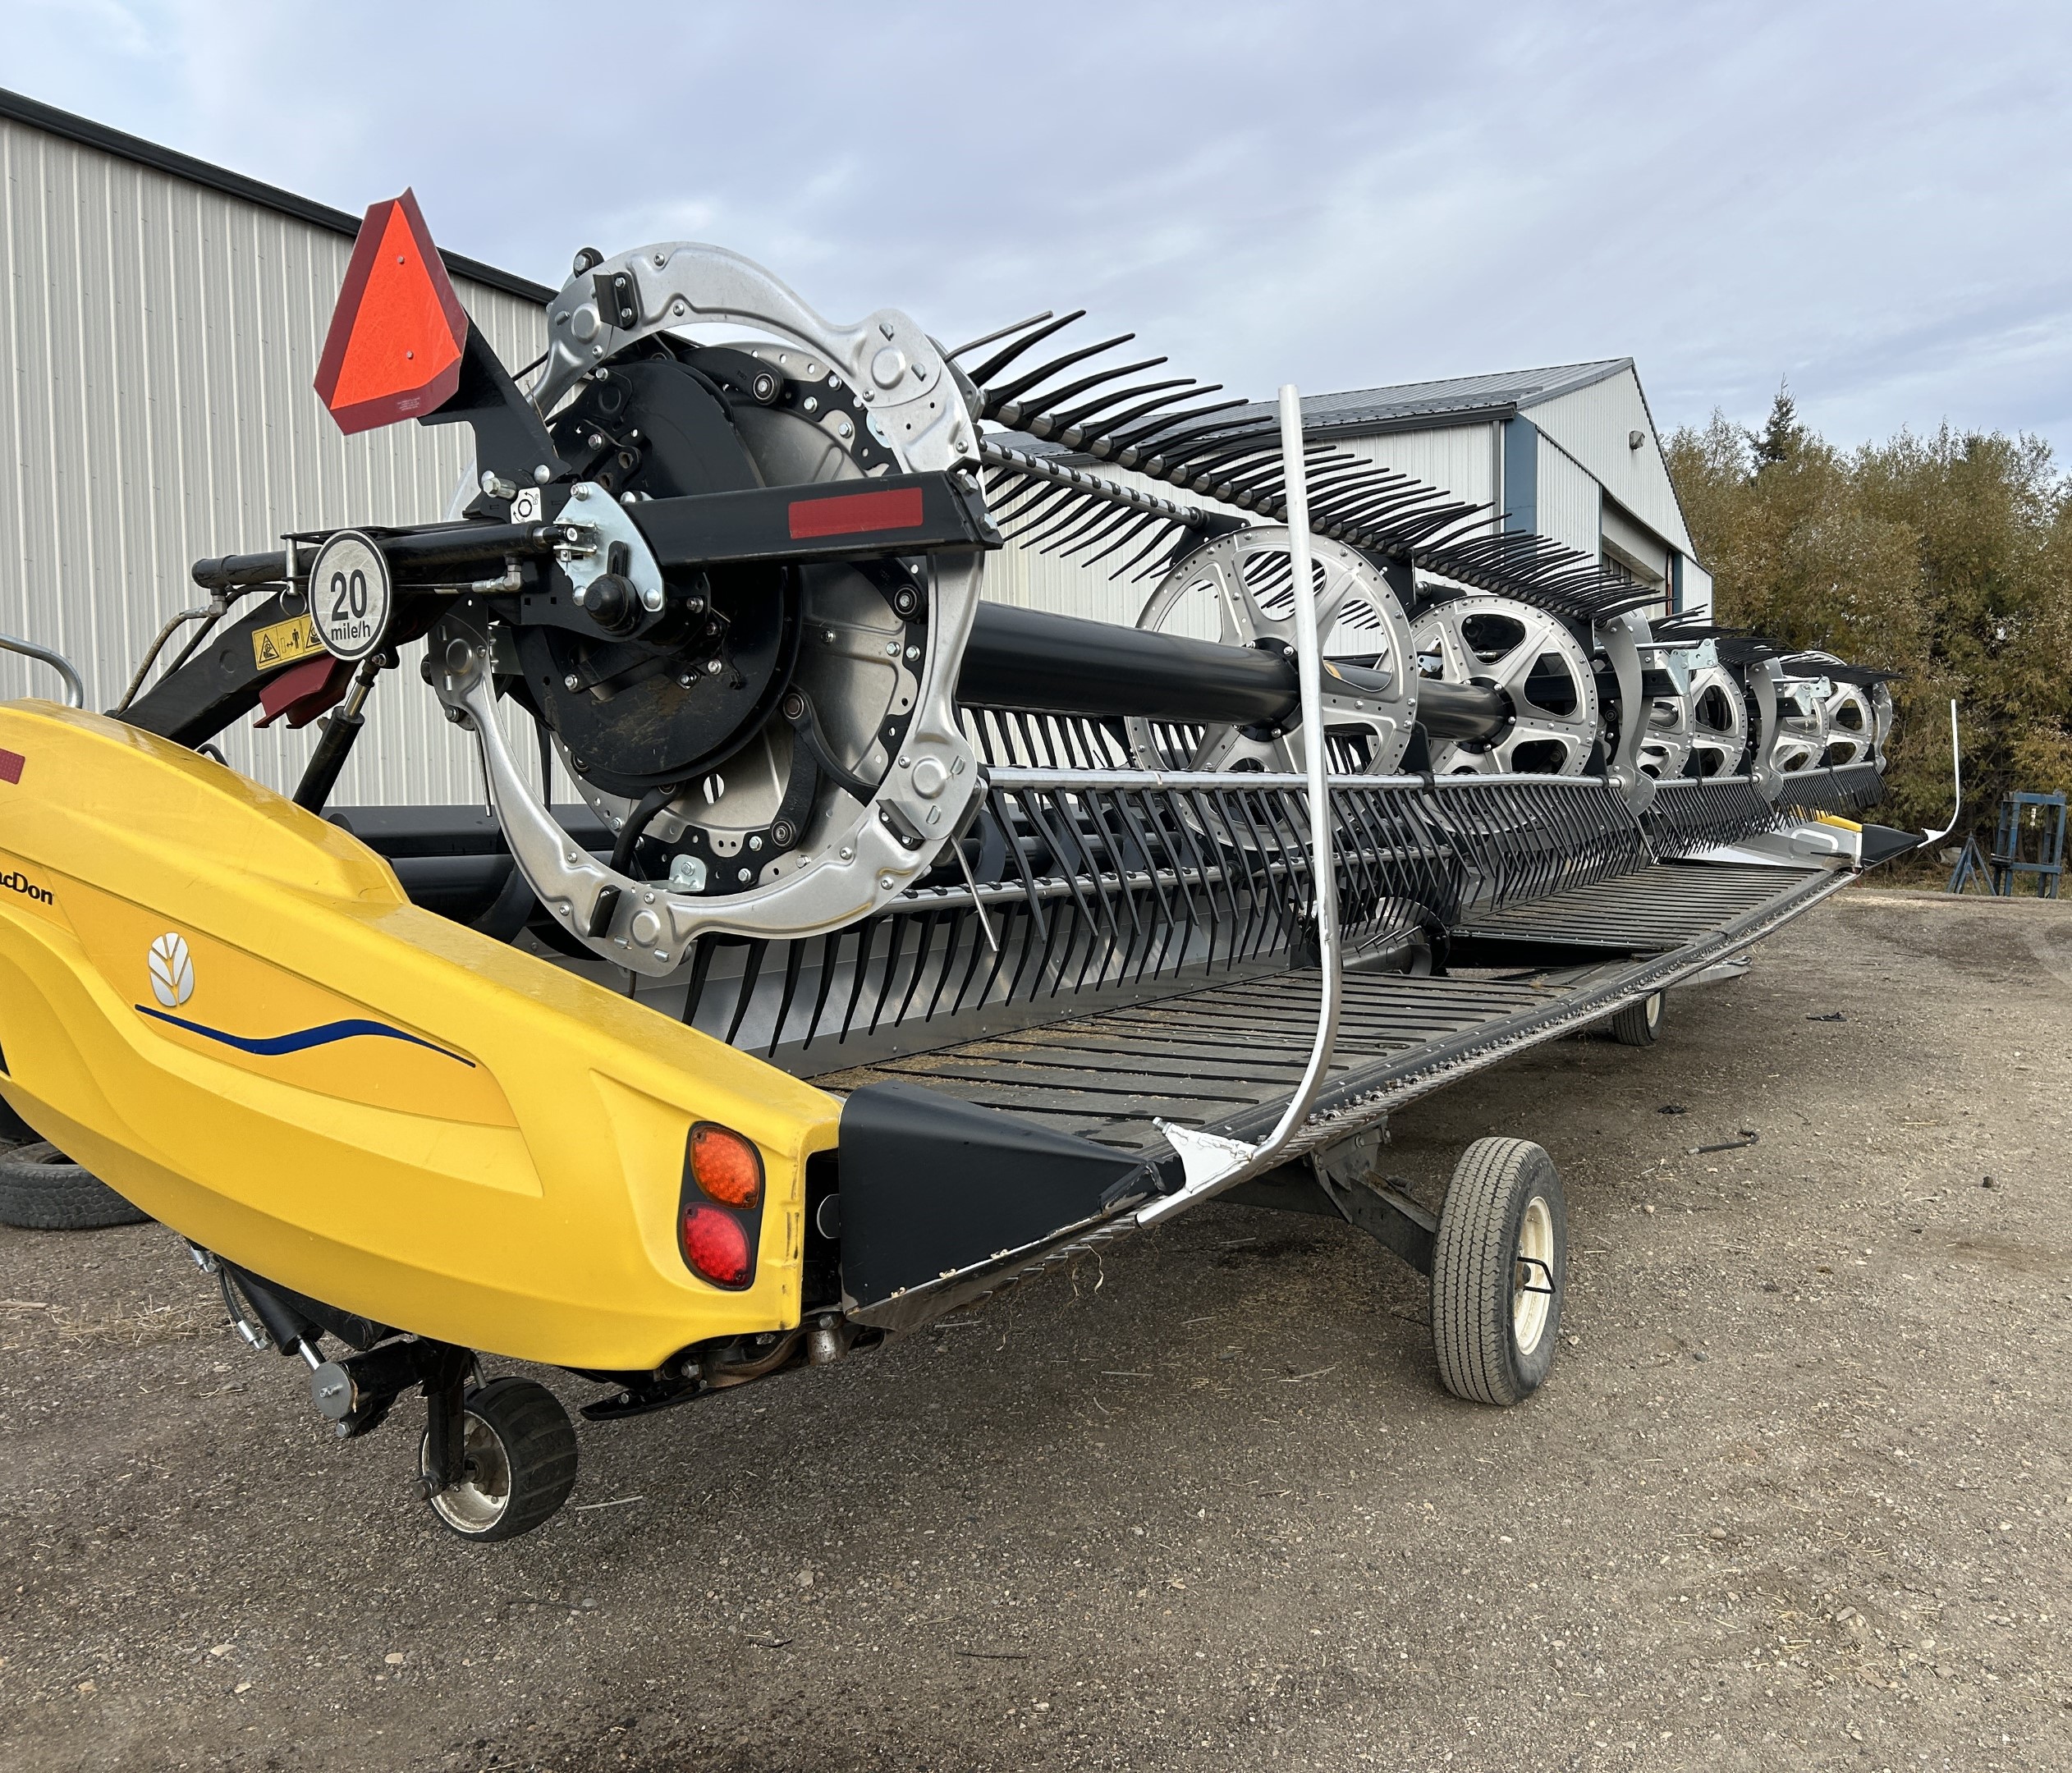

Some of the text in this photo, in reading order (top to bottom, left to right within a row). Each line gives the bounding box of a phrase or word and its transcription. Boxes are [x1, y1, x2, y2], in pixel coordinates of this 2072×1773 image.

[331, 570, 367, 621] 20
[331, 621, 370, 640] mile/h
[0, 871, 53, 905] cDon
